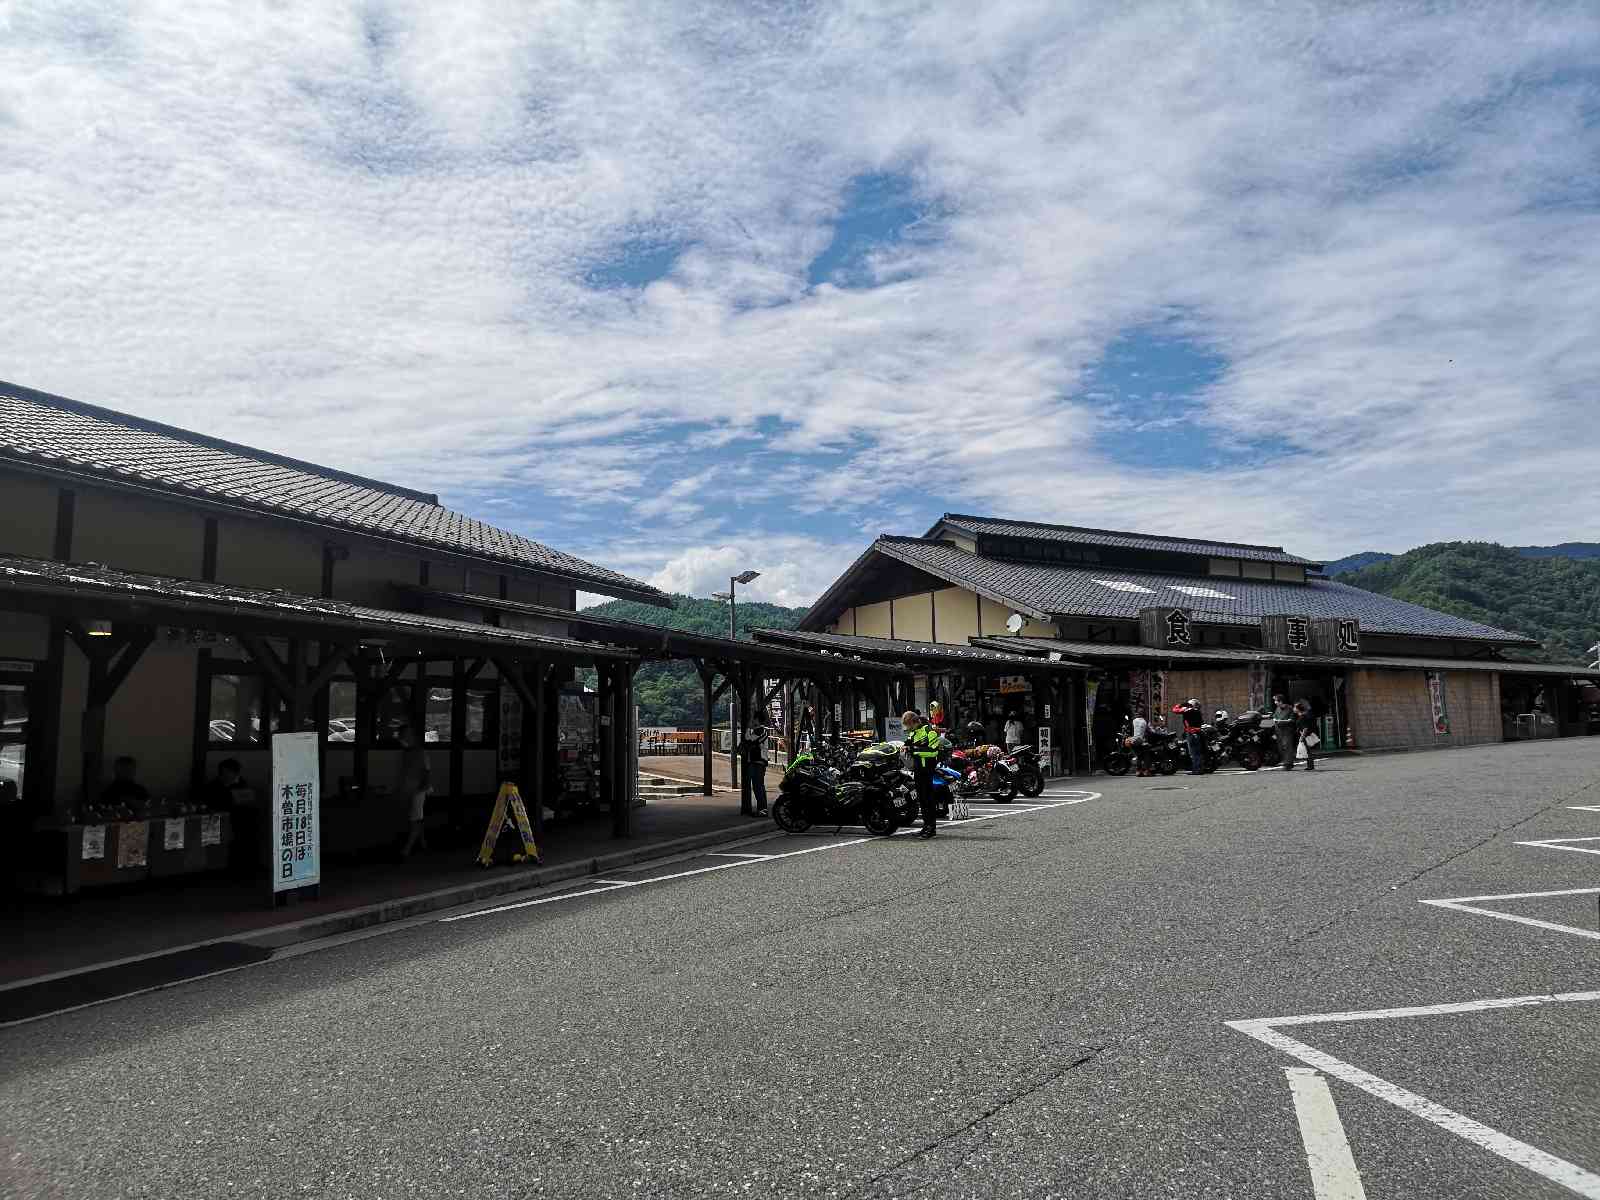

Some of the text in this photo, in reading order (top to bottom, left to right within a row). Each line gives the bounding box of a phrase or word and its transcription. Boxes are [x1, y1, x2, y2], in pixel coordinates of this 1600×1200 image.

[1166, 609, 1360, 651] 食事処
[281, 785, 293, 878] 木曽市場の日
[295, 783, 307, 862] 毎月18日は
